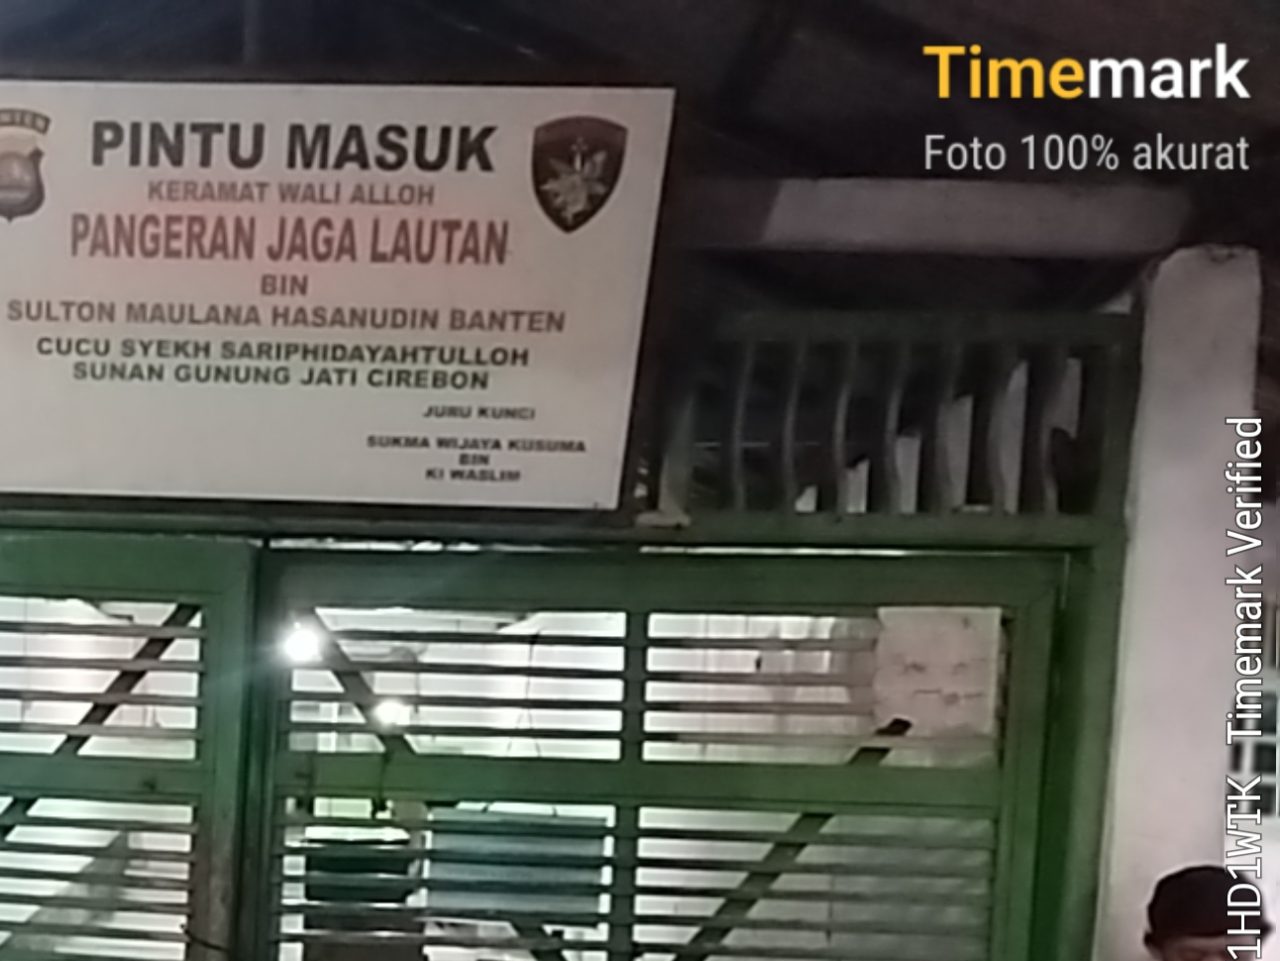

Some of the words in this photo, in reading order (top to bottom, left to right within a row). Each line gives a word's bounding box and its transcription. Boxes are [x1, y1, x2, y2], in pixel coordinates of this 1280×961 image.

[91, 121, 266, 169] PINTU
[286, 123, 498, 172] MASUK
[147, 180, 269, 203] KERAMAT
[278, 182, 341, 205] WALI
[349, 183, 435, 206] ALLOH
[70, 213, 256, 260] PANGERAN
[266, 216, 358, 262] JAGA
[369, 218, 509, 265] LAUTAN
[260, 274, 309, 297] BIN
[7, 299, 116, 323] SULTON
[125, 302, 262, 326] MAULANA
[271, 305, 439, 331] HASANUDIN
[448, 307, 566, 333] BANTEN
[36, 336, 111, 356] CUCU
[120, 338, 211, 359] SYEKH
[220, 340, 530, 366] SARIPHIDAYAHTULLOH
[73, 361, 165, 381] SUNAN
[173, 363, 290, 385] GUNUNG
[300, 366, 357, 387] JATI
[366, 367, 490, 390] CIREBON
[422, 405, 472, 419] JURU
[477, 406, 536, 421] KUNCI
[366, 435, 430, 449] SUKMA
[435, 436, 503, 451] WIJAYA
[507, 438, 587, 453] KUSUMA
[458, 453, 491, 466] BIN
[425, 468, 445, 481] KI
